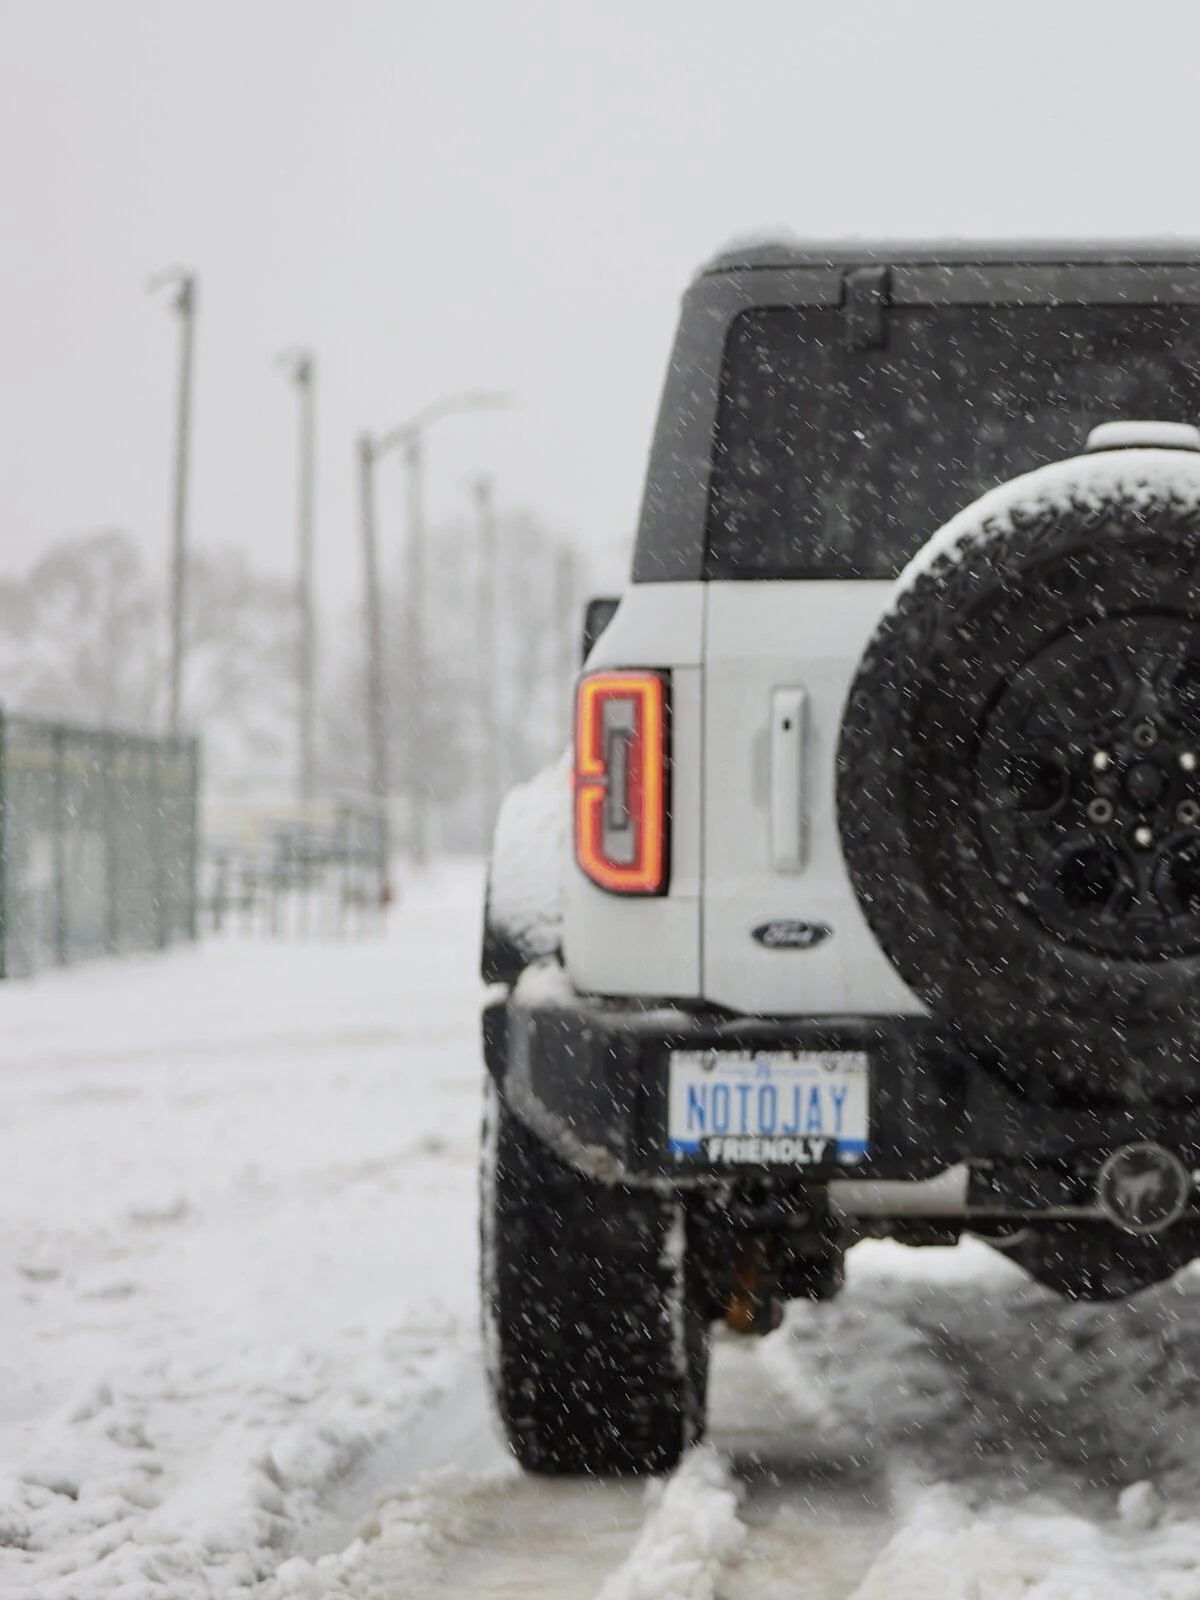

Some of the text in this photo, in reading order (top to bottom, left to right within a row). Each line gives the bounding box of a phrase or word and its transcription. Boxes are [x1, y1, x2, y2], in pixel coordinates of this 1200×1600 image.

[760, 921, 818, 949] Ford
[686, 1083, 847, 1134] NOTOJAY
[706, 1137, 828, 1165] FRIENDLY
